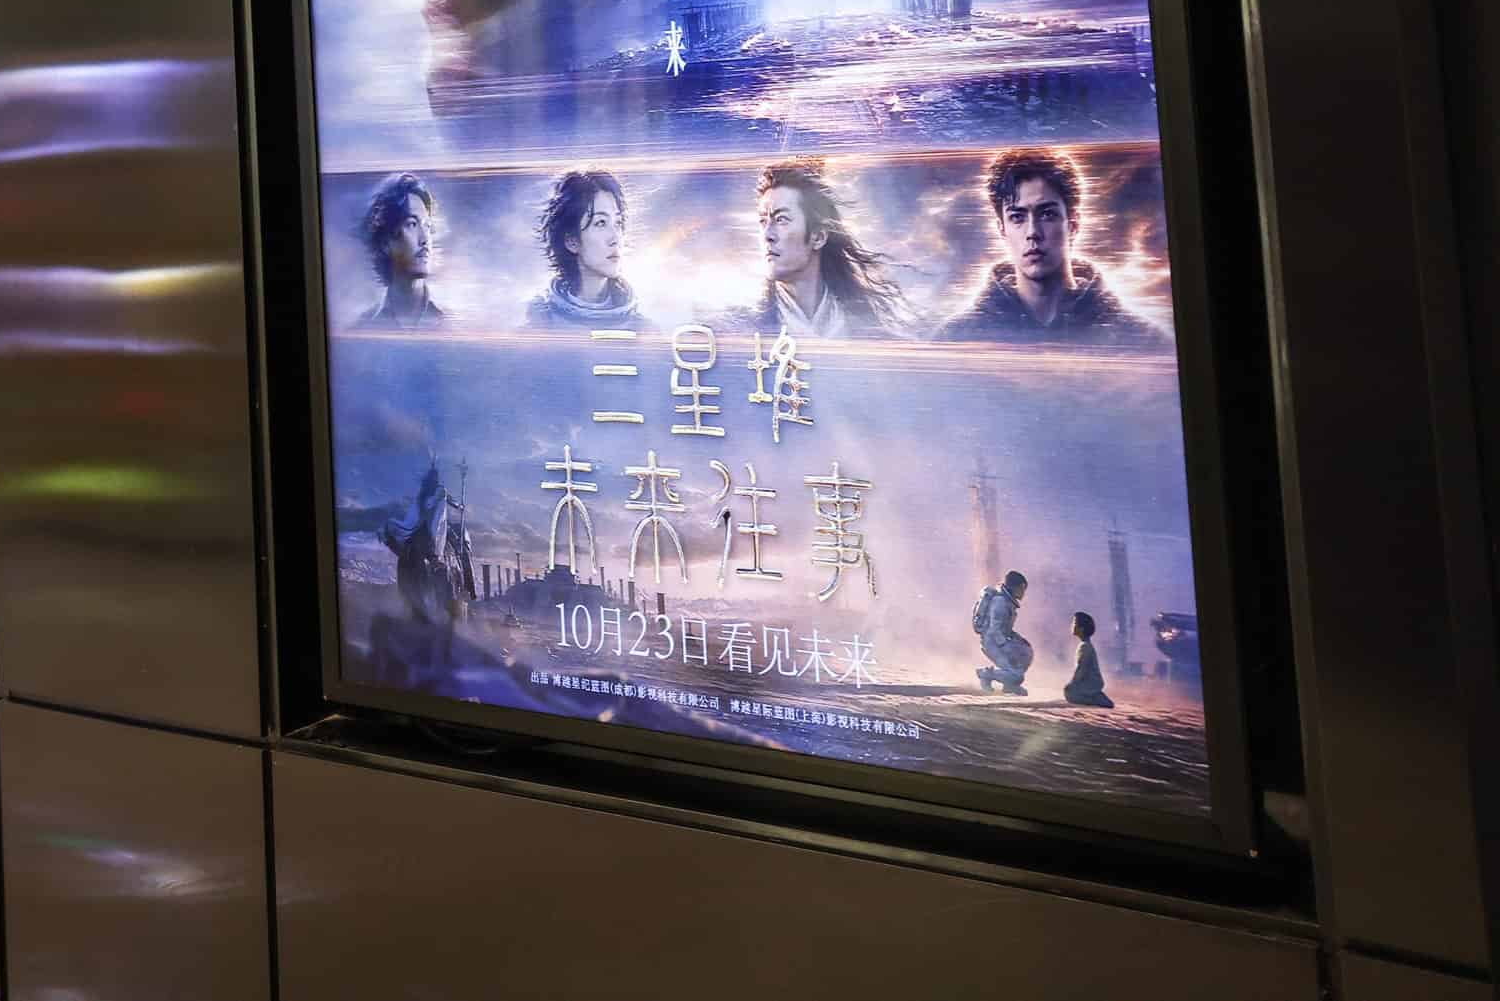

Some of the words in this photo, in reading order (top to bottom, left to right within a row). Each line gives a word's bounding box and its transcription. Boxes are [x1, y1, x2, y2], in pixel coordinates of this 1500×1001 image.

[590, 324, 815, 443] 三星堆
[540, 445, 878, 602] 未来往事
[555, 602, 877, 689] 10月23日看见未来
